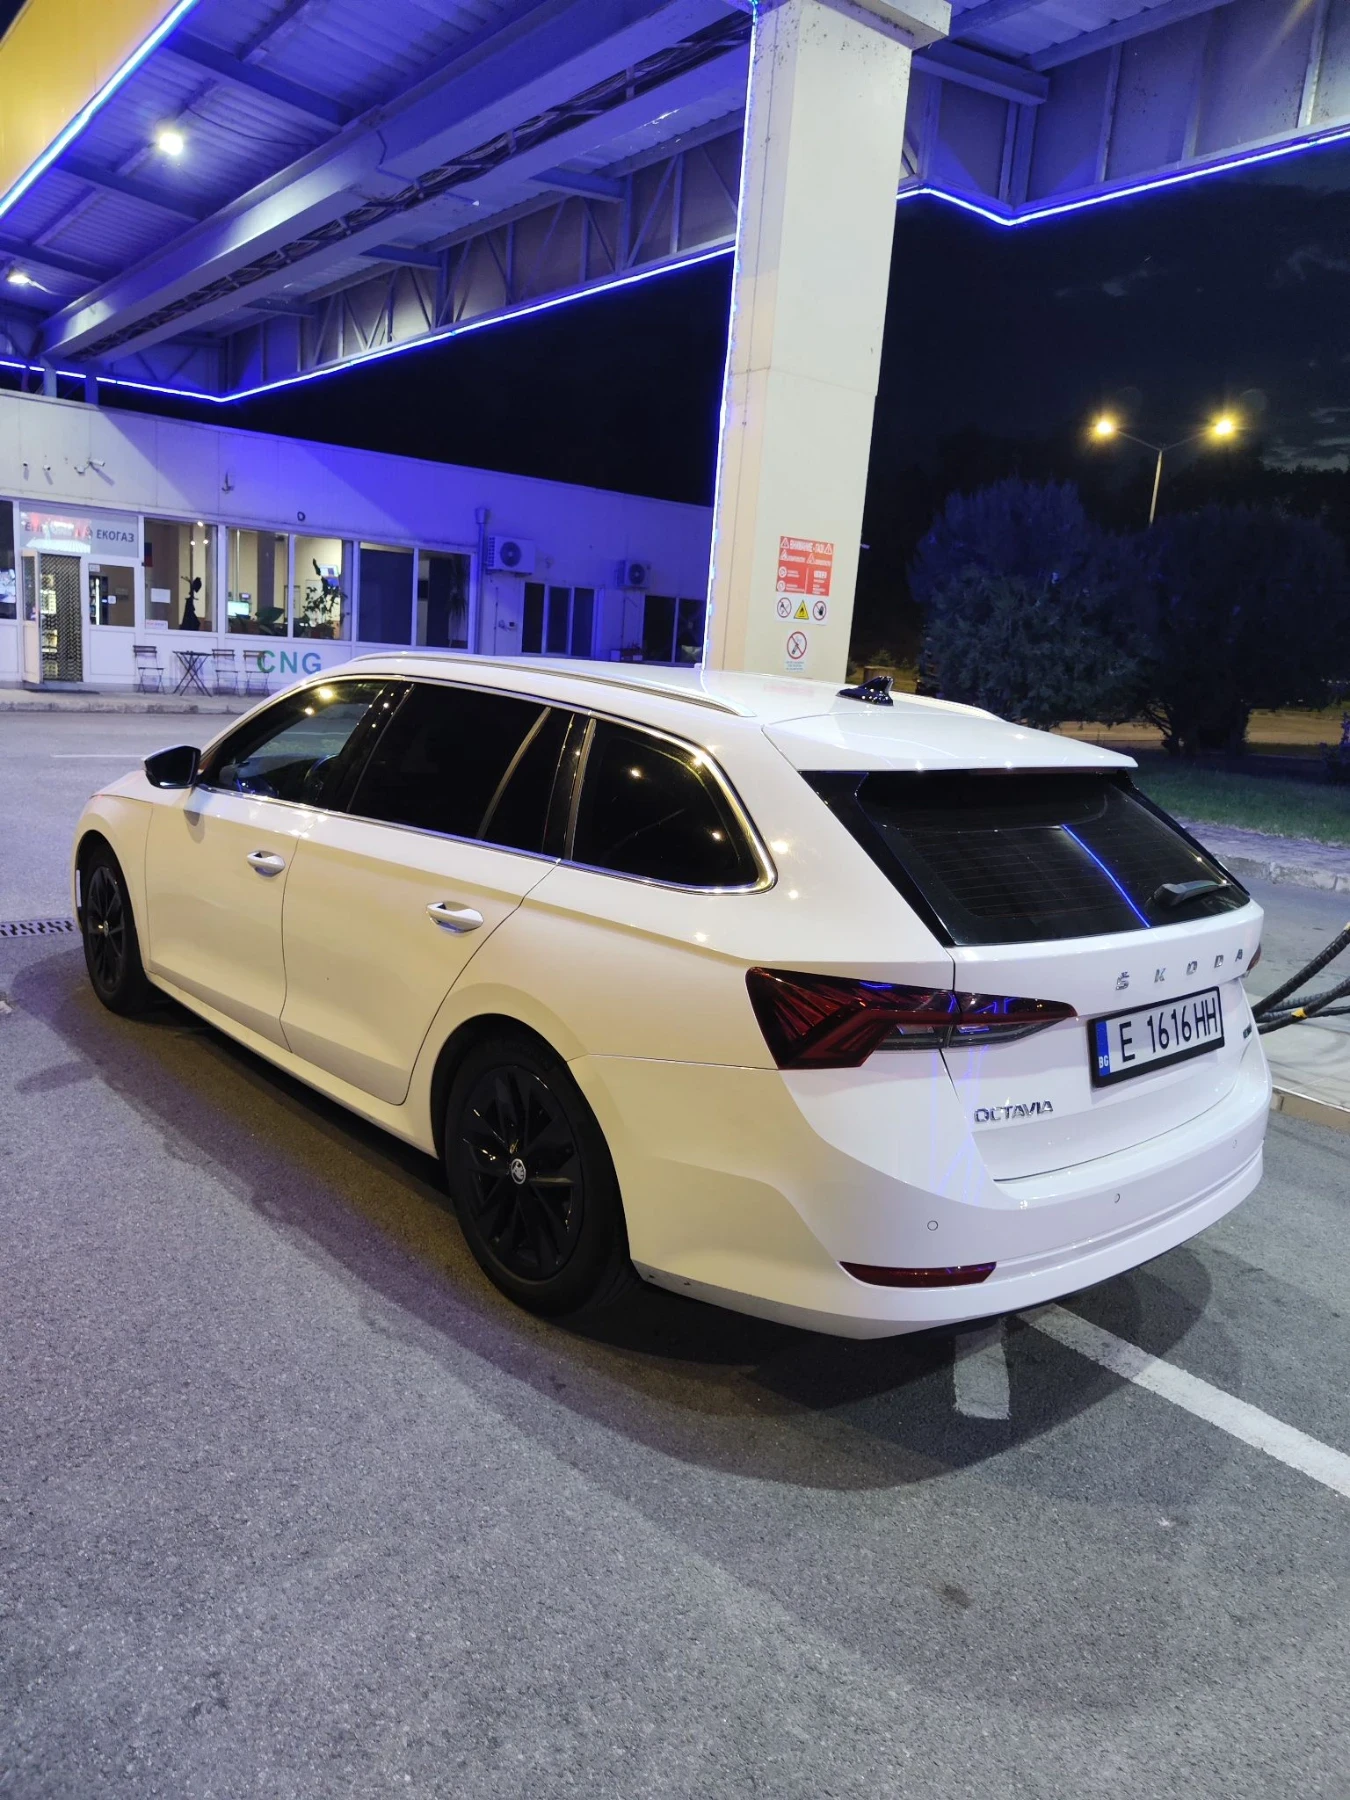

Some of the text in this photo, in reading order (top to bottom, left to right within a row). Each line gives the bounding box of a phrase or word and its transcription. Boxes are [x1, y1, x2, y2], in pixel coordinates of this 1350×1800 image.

[96, 529, 135, 543] ЕКОГАЗ
[258, 651, 322, 675] CNG
[1119, 1021, 1136, 1063] E
[1098, 1055, 1110, 1069] BG
[974, 1101, 1054, 1122] OCTAVIA
